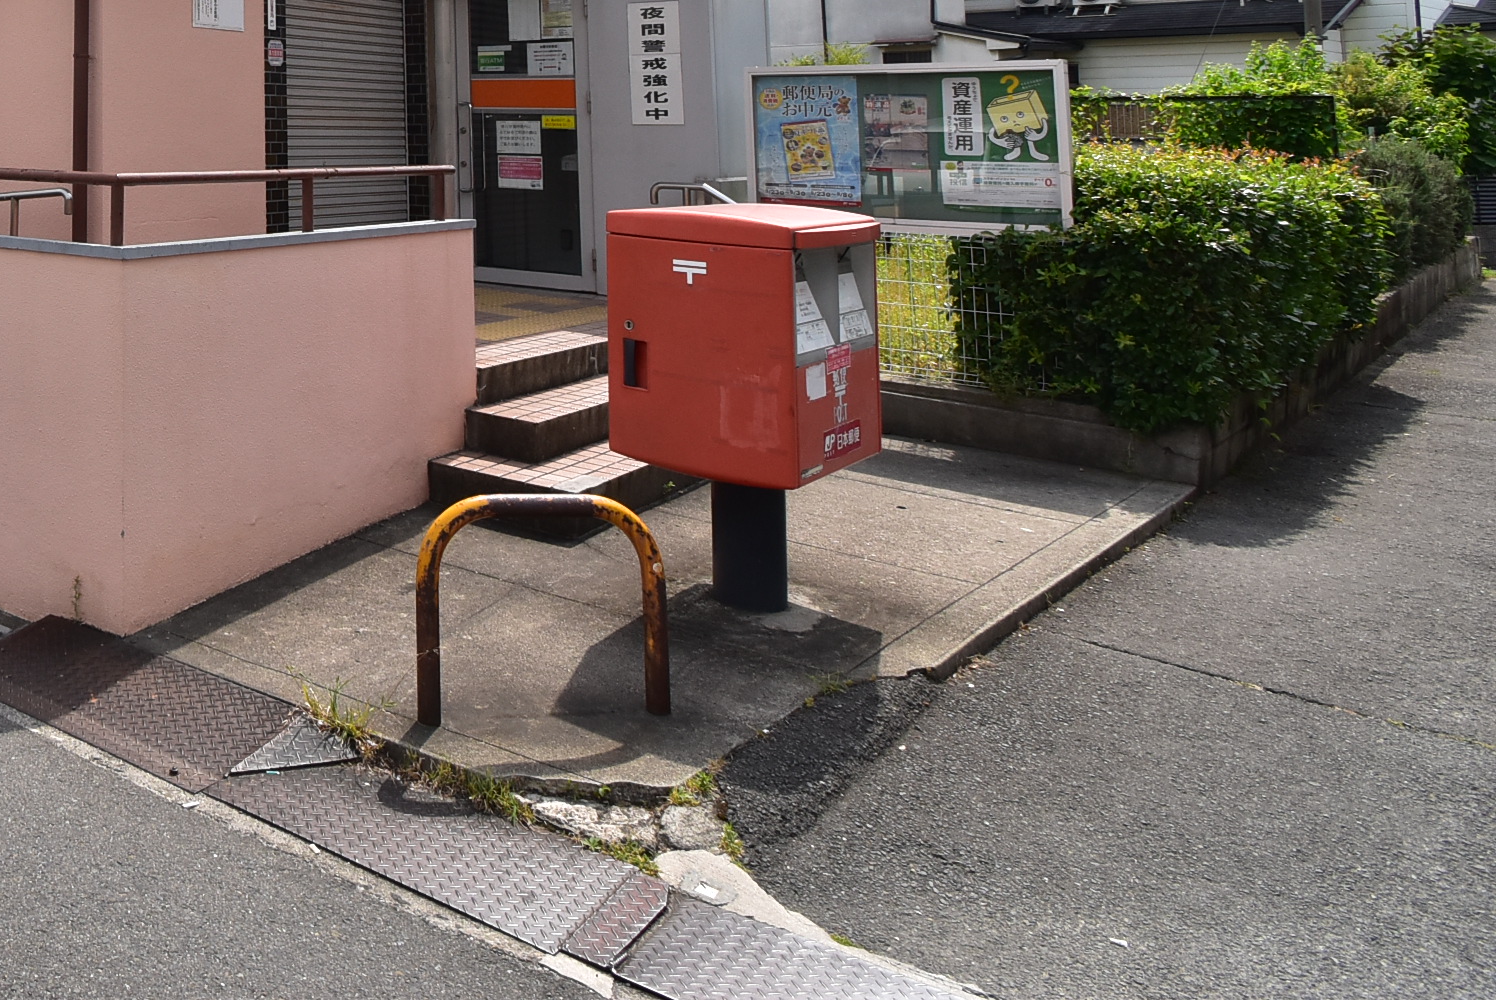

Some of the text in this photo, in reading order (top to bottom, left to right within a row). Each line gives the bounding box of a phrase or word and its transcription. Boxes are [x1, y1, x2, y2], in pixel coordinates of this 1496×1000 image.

[639, 6, 669, 120] 夜間警戒強化中
[782, 85, 845, 101] 郵便局の
[782, 101, 833, 118] お中元
[951, 81, 974, 152] 資産運用
[836, 426, 860, 451] 日本郵便
